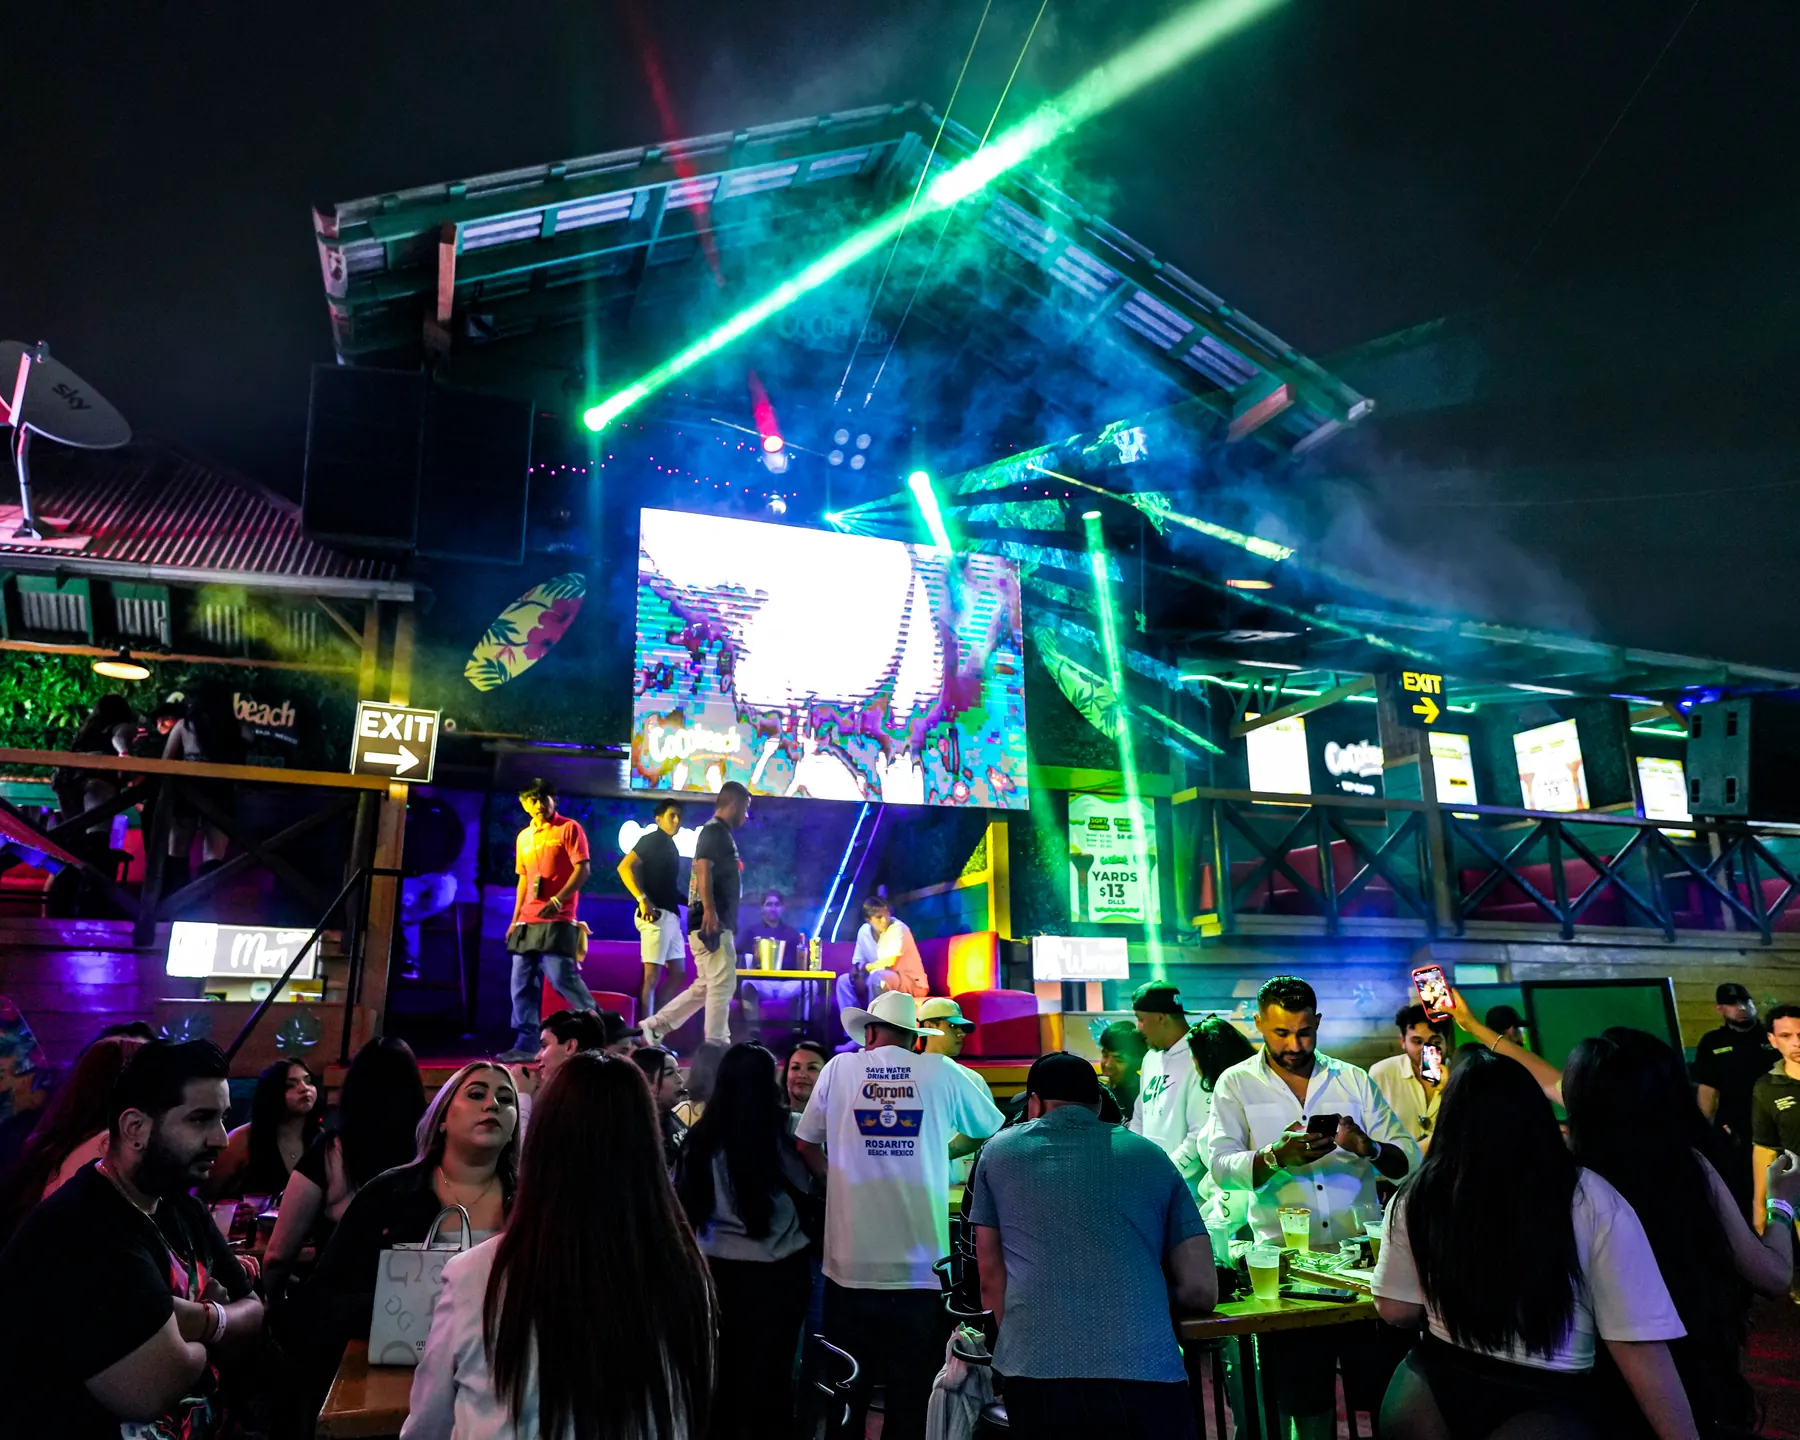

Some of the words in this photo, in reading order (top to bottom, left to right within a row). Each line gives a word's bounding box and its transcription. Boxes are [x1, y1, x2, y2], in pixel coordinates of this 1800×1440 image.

[51, 383, 92, 410] sky
[1402, 671, 1442, 695] EXIT
[360, 709, 434, 743] EXIT
[1092, 871, 1138, 883] YARDS
[1100, 883, 1125, 898] $13
[865, 1066, 885, 1074] SAVE
[886, 1066, 911, 1074] WATER
[862, 1082, 914, 1101] Corona
[865, 1139, 915, 1149] ROSARITO
[890, 1149, 914, 1157] MEXICO
